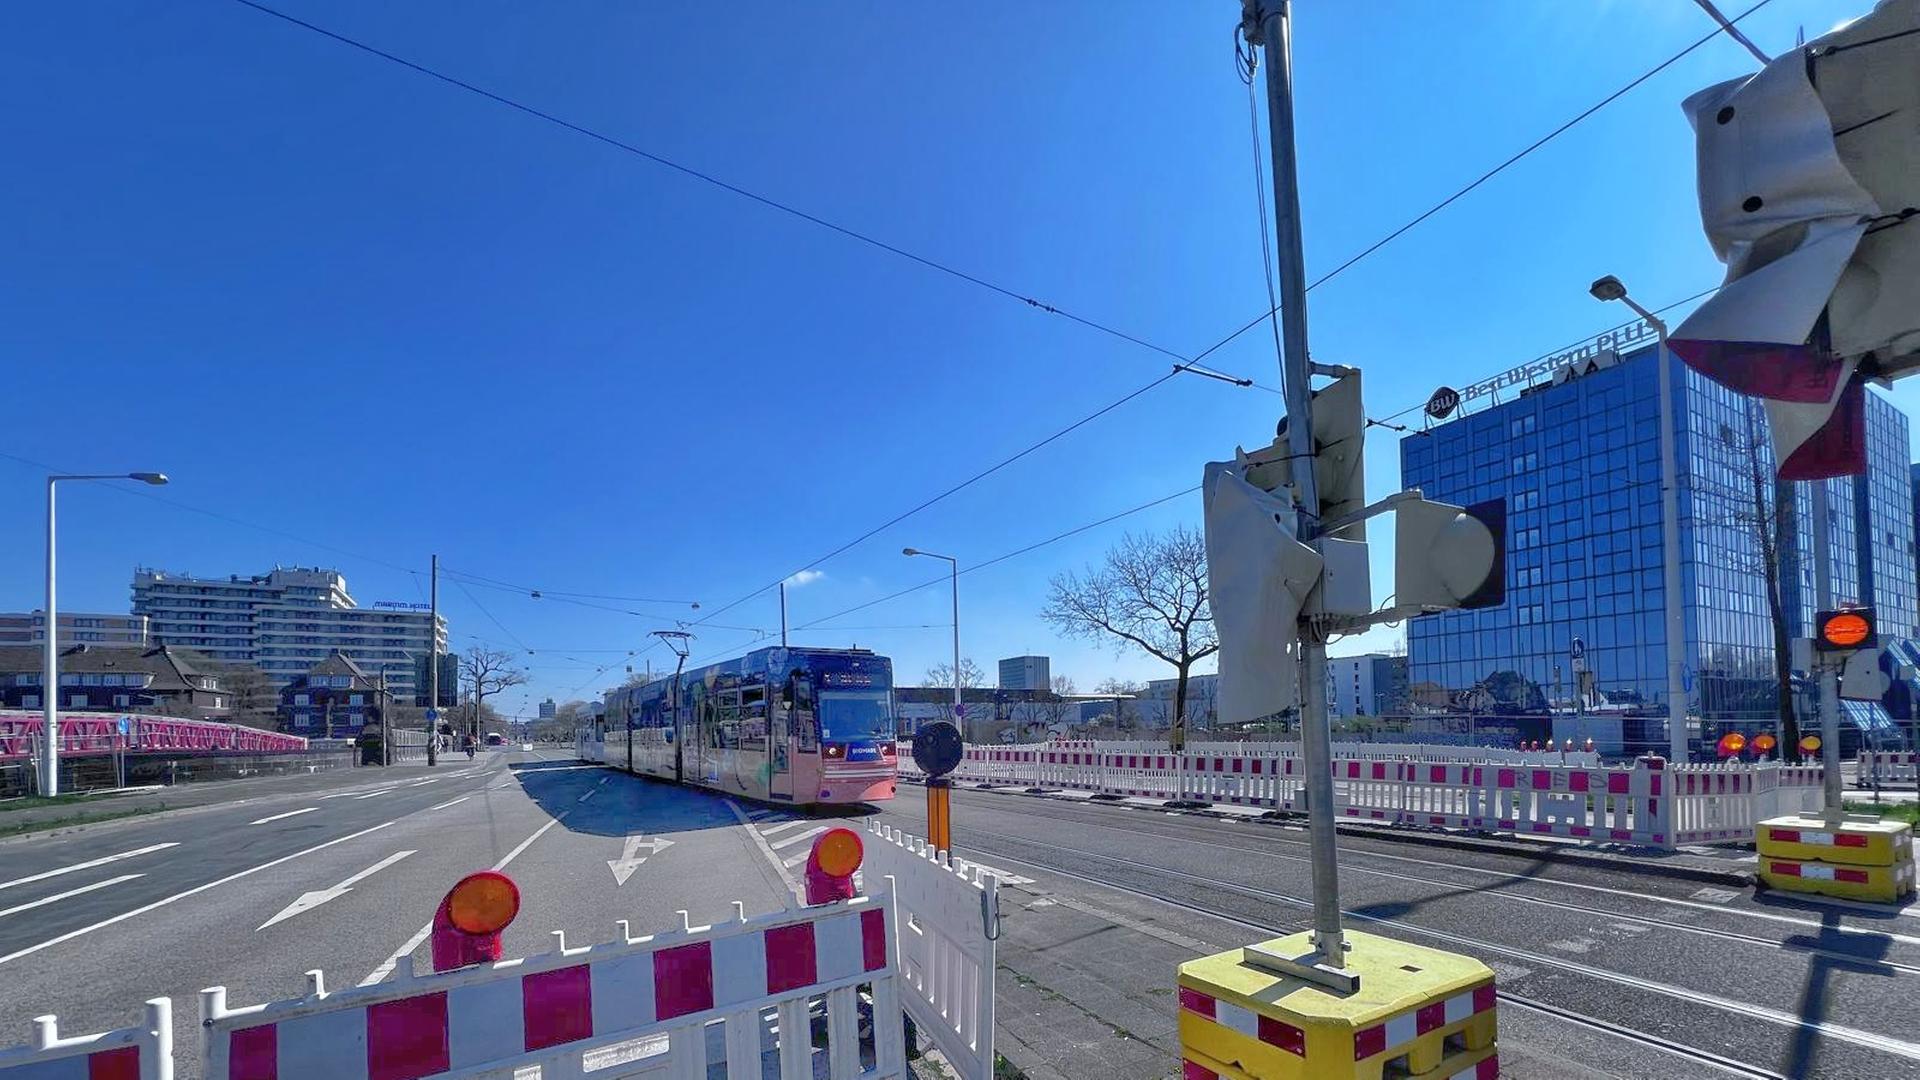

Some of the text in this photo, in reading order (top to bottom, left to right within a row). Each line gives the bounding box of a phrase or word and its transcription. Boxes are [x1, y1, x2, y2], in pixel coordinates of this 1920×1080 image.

[1465, 377, 1502, 401] Best
[1507, 346, 1591, 385] Western
[1430, 396, 1456, 414] BW
